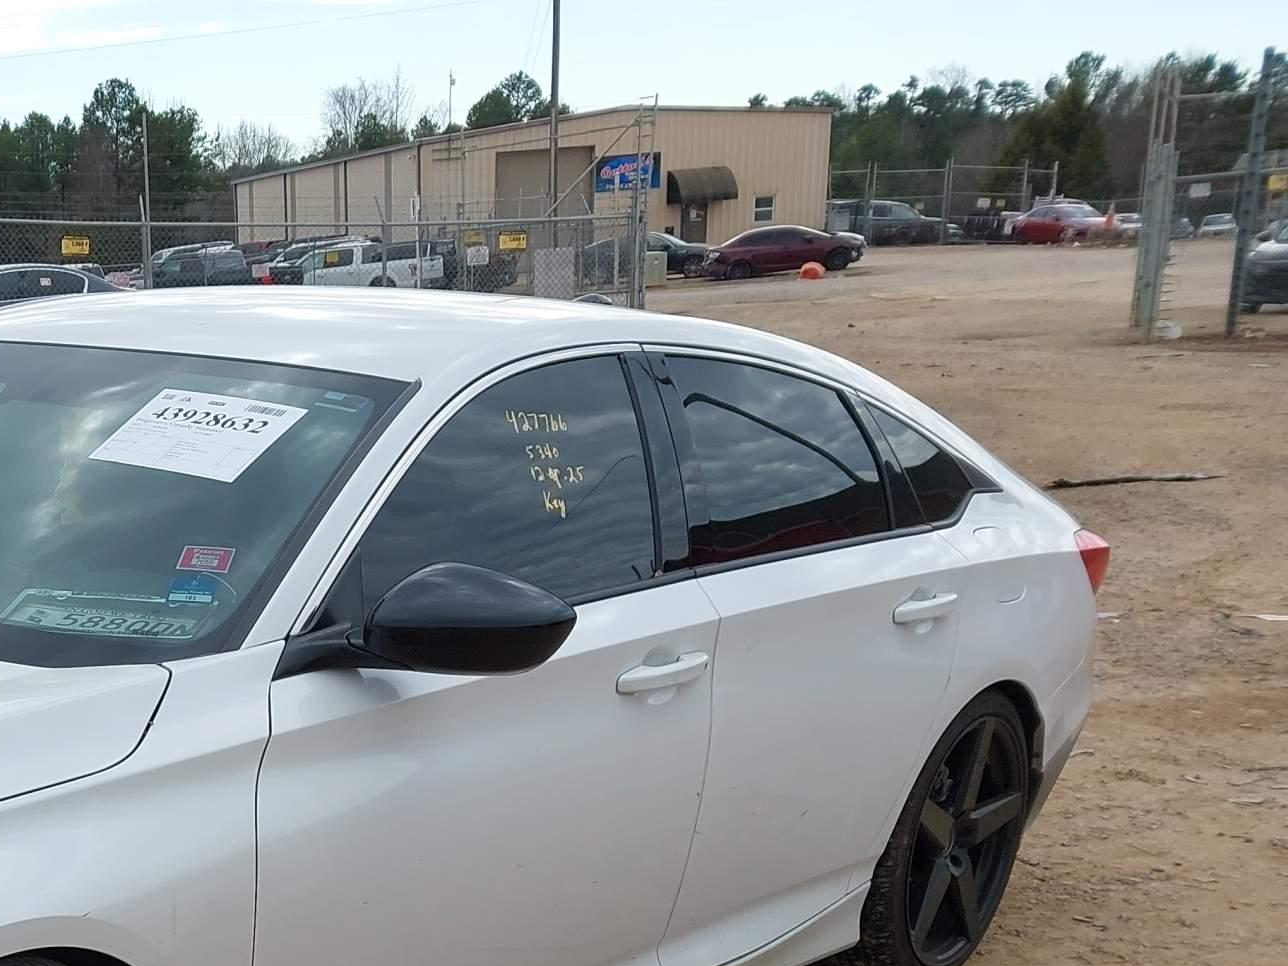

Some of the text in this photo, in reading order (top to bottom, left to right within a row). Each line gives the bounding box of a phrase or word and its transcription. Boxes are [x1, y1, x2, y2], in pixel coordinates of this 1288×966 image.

[152, 406, 269, 434] 43928632
[505, 409, 568, 434] 427766
[525, 443, 560, 459] 5340
